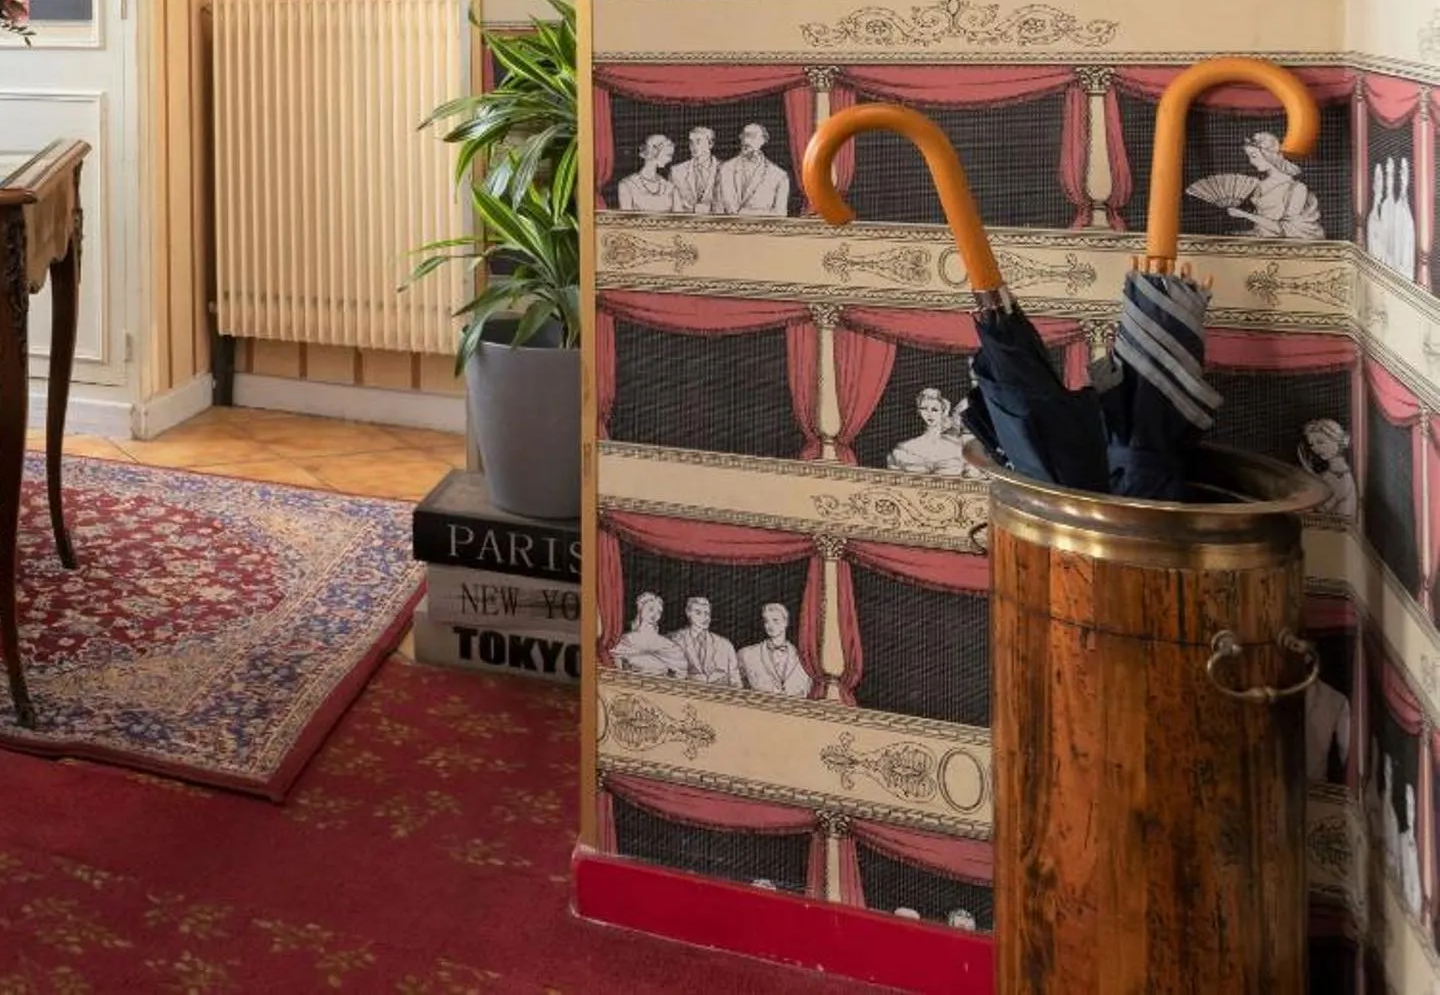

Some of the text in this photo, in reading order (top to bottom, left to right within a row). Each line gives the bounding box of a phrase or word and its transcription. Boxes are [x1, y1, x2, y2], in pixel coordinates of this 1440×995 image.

[448, 524, 581, 574] PARIS
[461, 582, 581, 621] NEW YO
[453, 625, 581, 679] TOKYO
